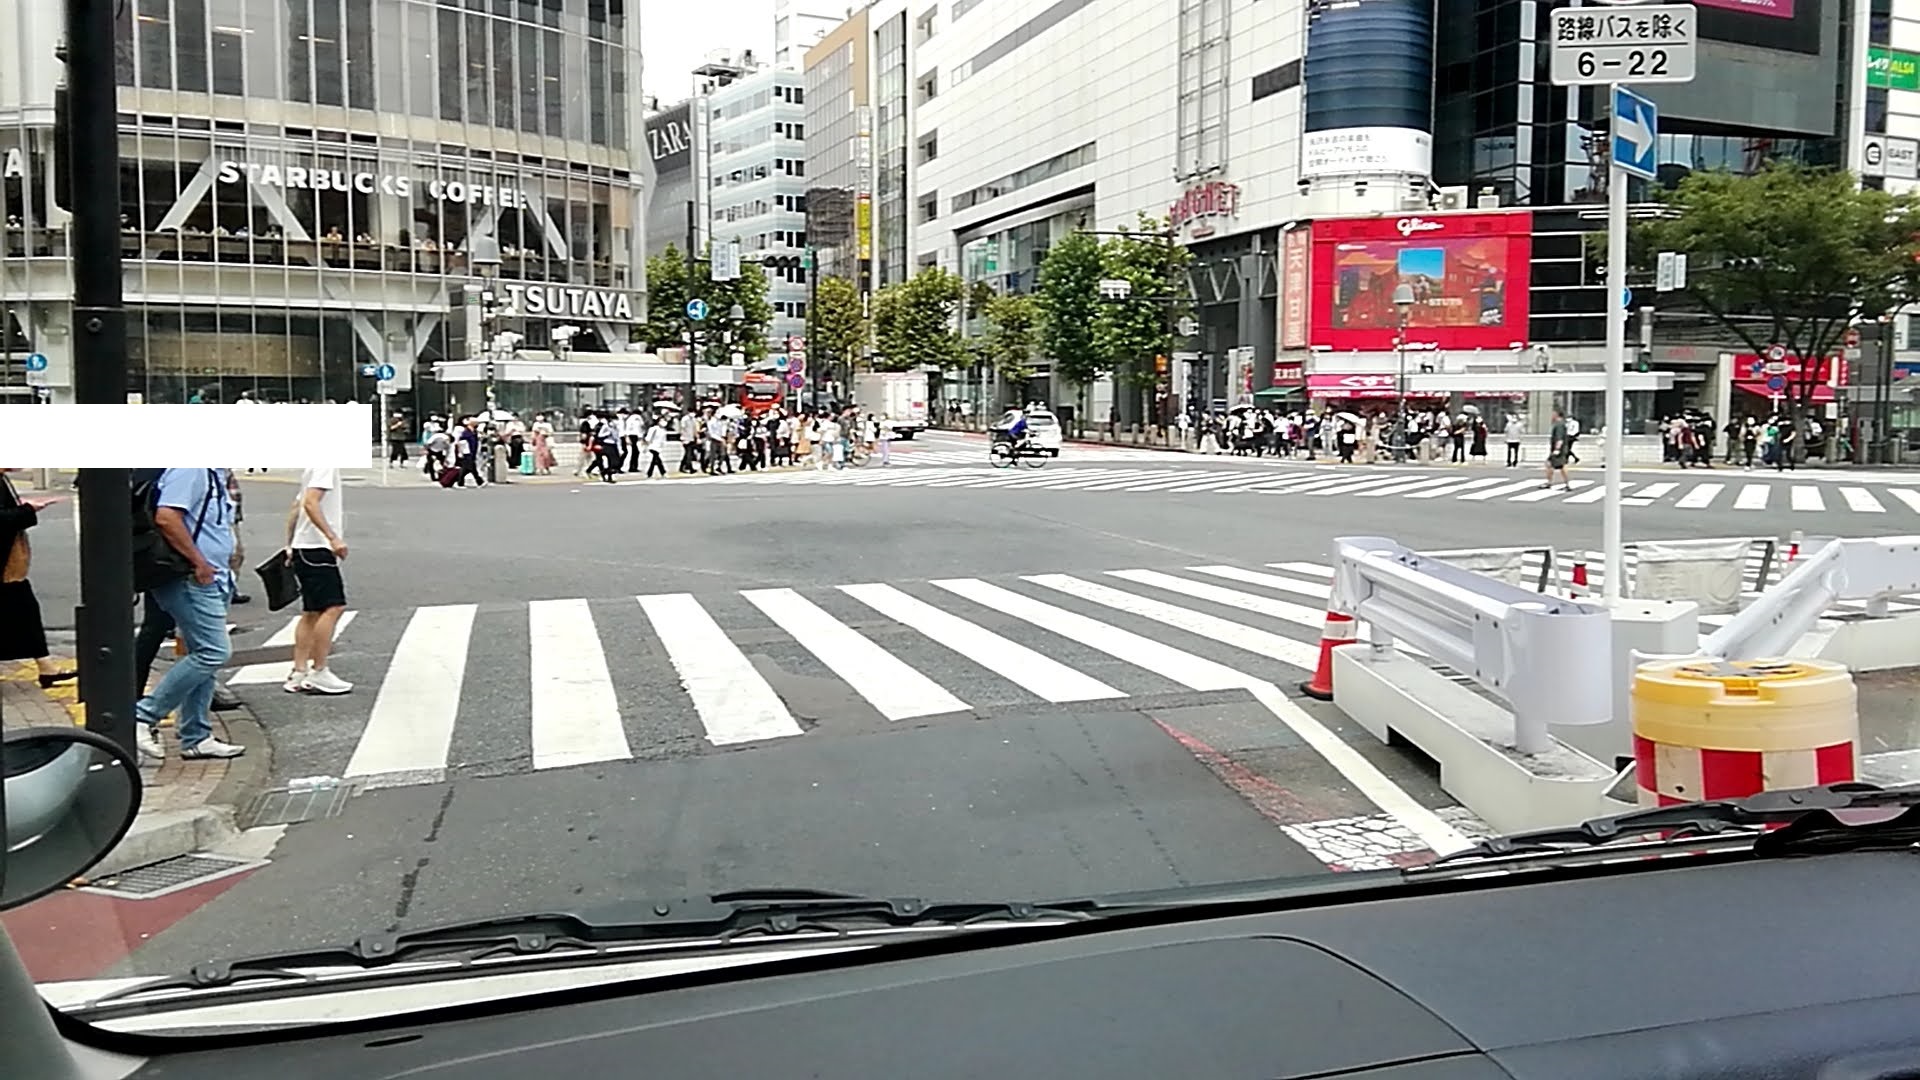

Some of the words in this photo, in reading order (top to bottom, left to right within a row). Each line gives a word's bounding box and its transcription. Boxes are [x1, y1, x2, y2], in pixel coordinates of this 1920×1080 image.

[1557, 14, 1687, 41] 路線バスを除く
[1886, 148, 1914, 160] EAST
[218, 161, 411, 197] STARBUCKS
[429, 180, 527, 210] COFFEE
[1396, 217, 1445, 237] Glico
[505, 284, 632, 319] TSUTAYA
